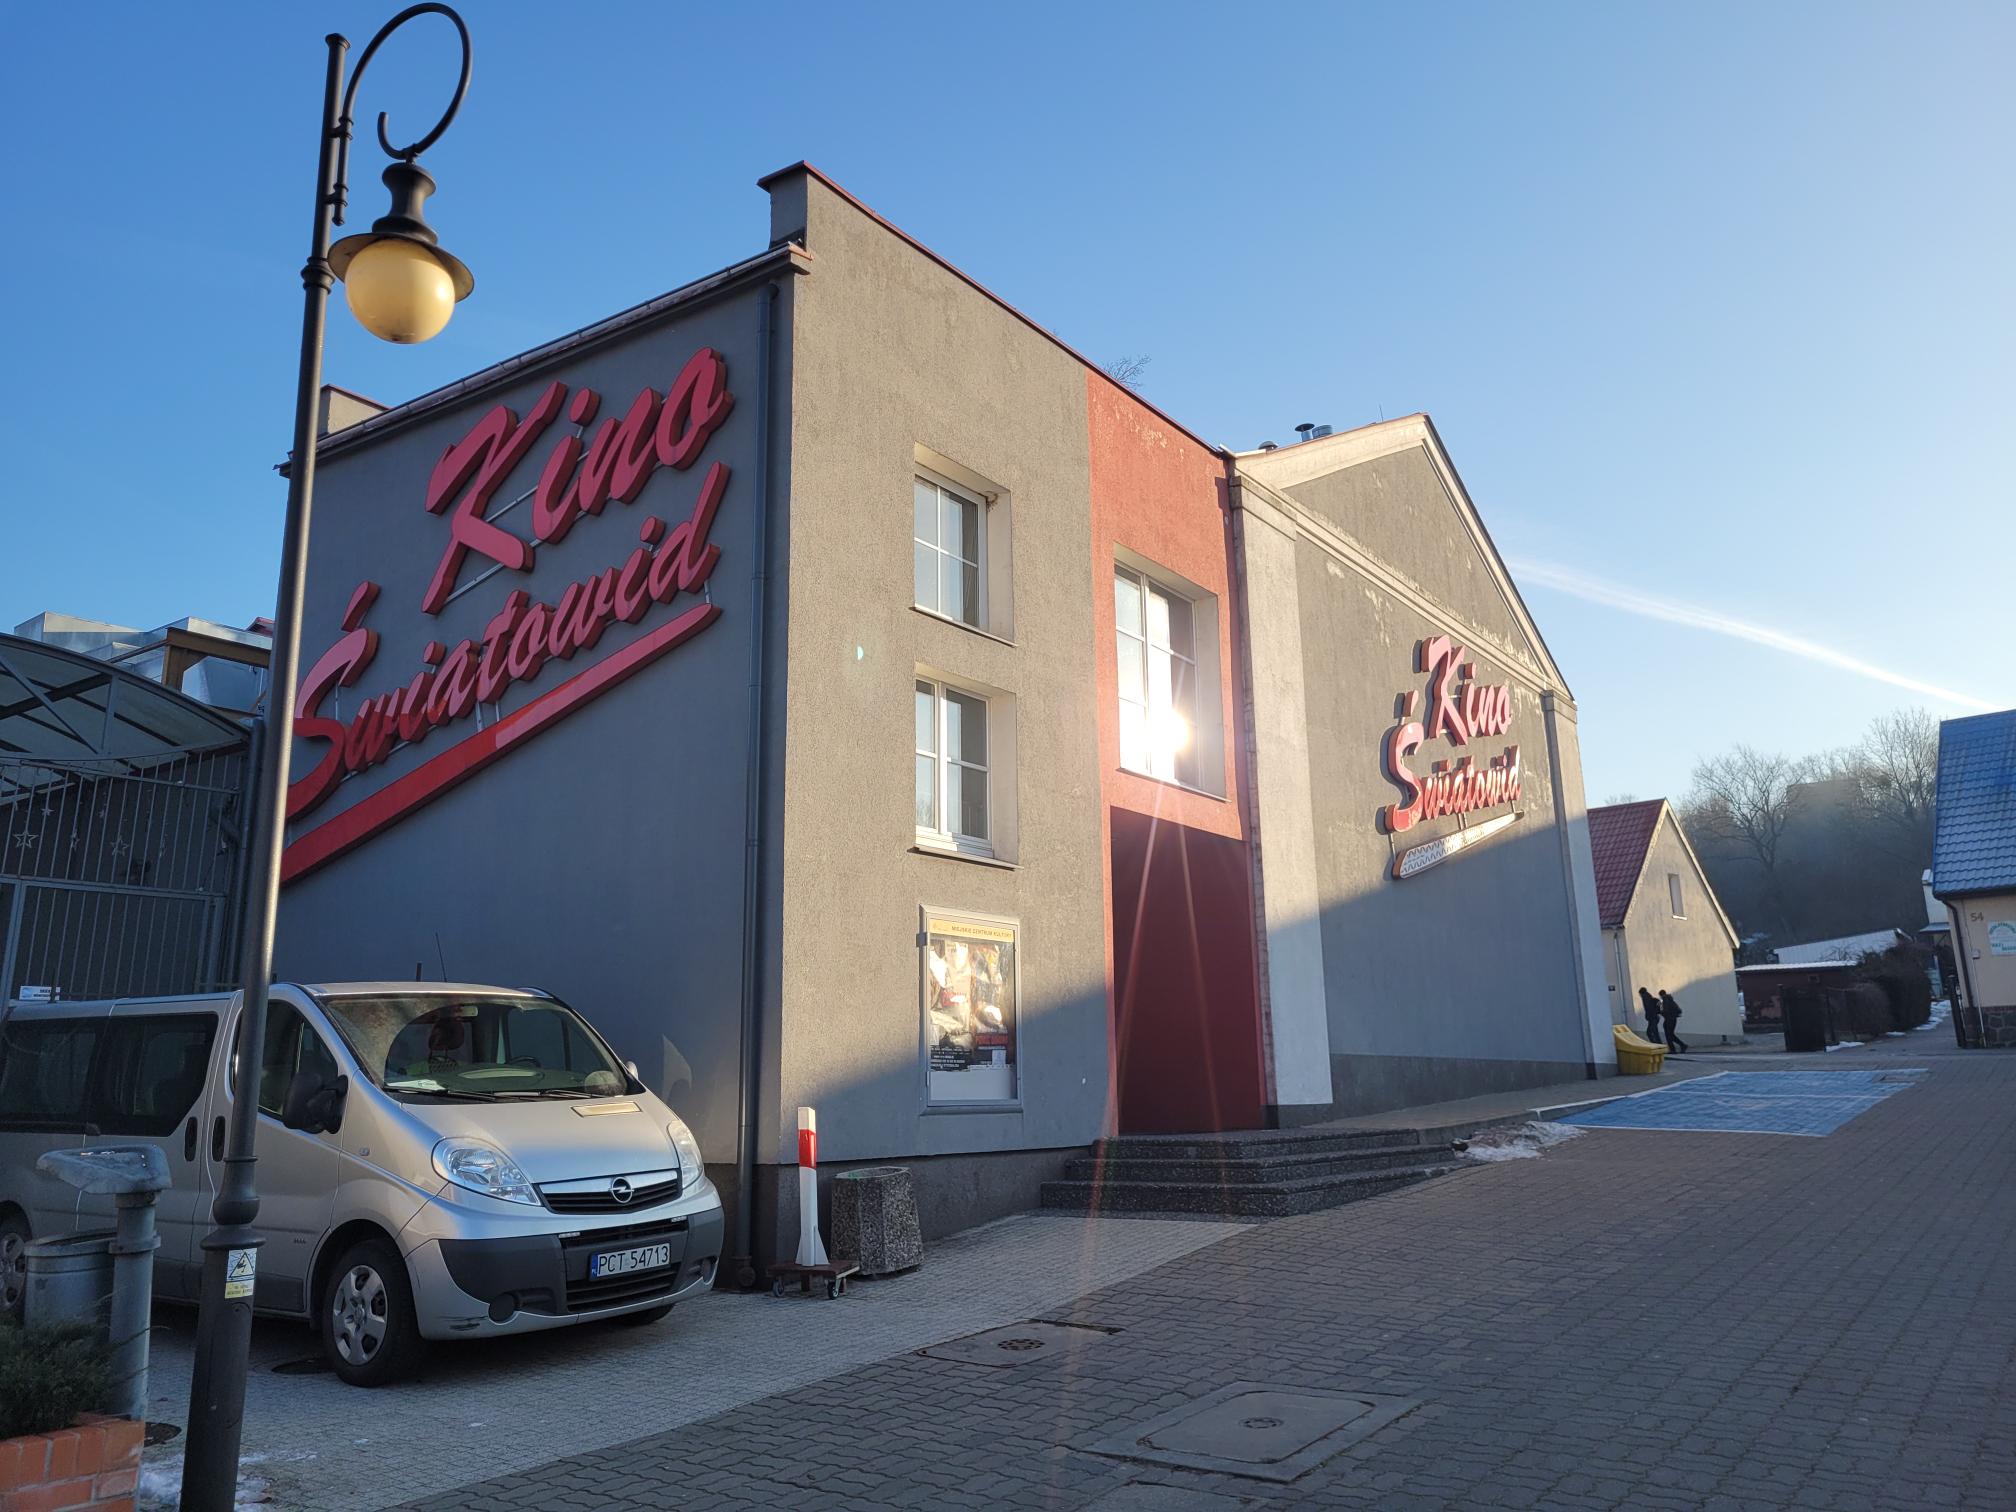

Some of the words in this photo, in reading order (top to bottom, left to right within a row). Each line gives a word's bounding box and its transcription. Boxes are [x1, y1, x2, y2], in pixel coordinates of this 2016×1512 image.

[422, 346, 735, 615] Kino
[287, 462, 730, 820] Światowid
[1422, 634, 1513, 745] Kino
[1387, 690, 1522, 832] Światowid
[1970, 912, 1984, 922] 54
[597, 1253, 625, 1275] PCT
[630, 1246, 669, 1269] 54713
